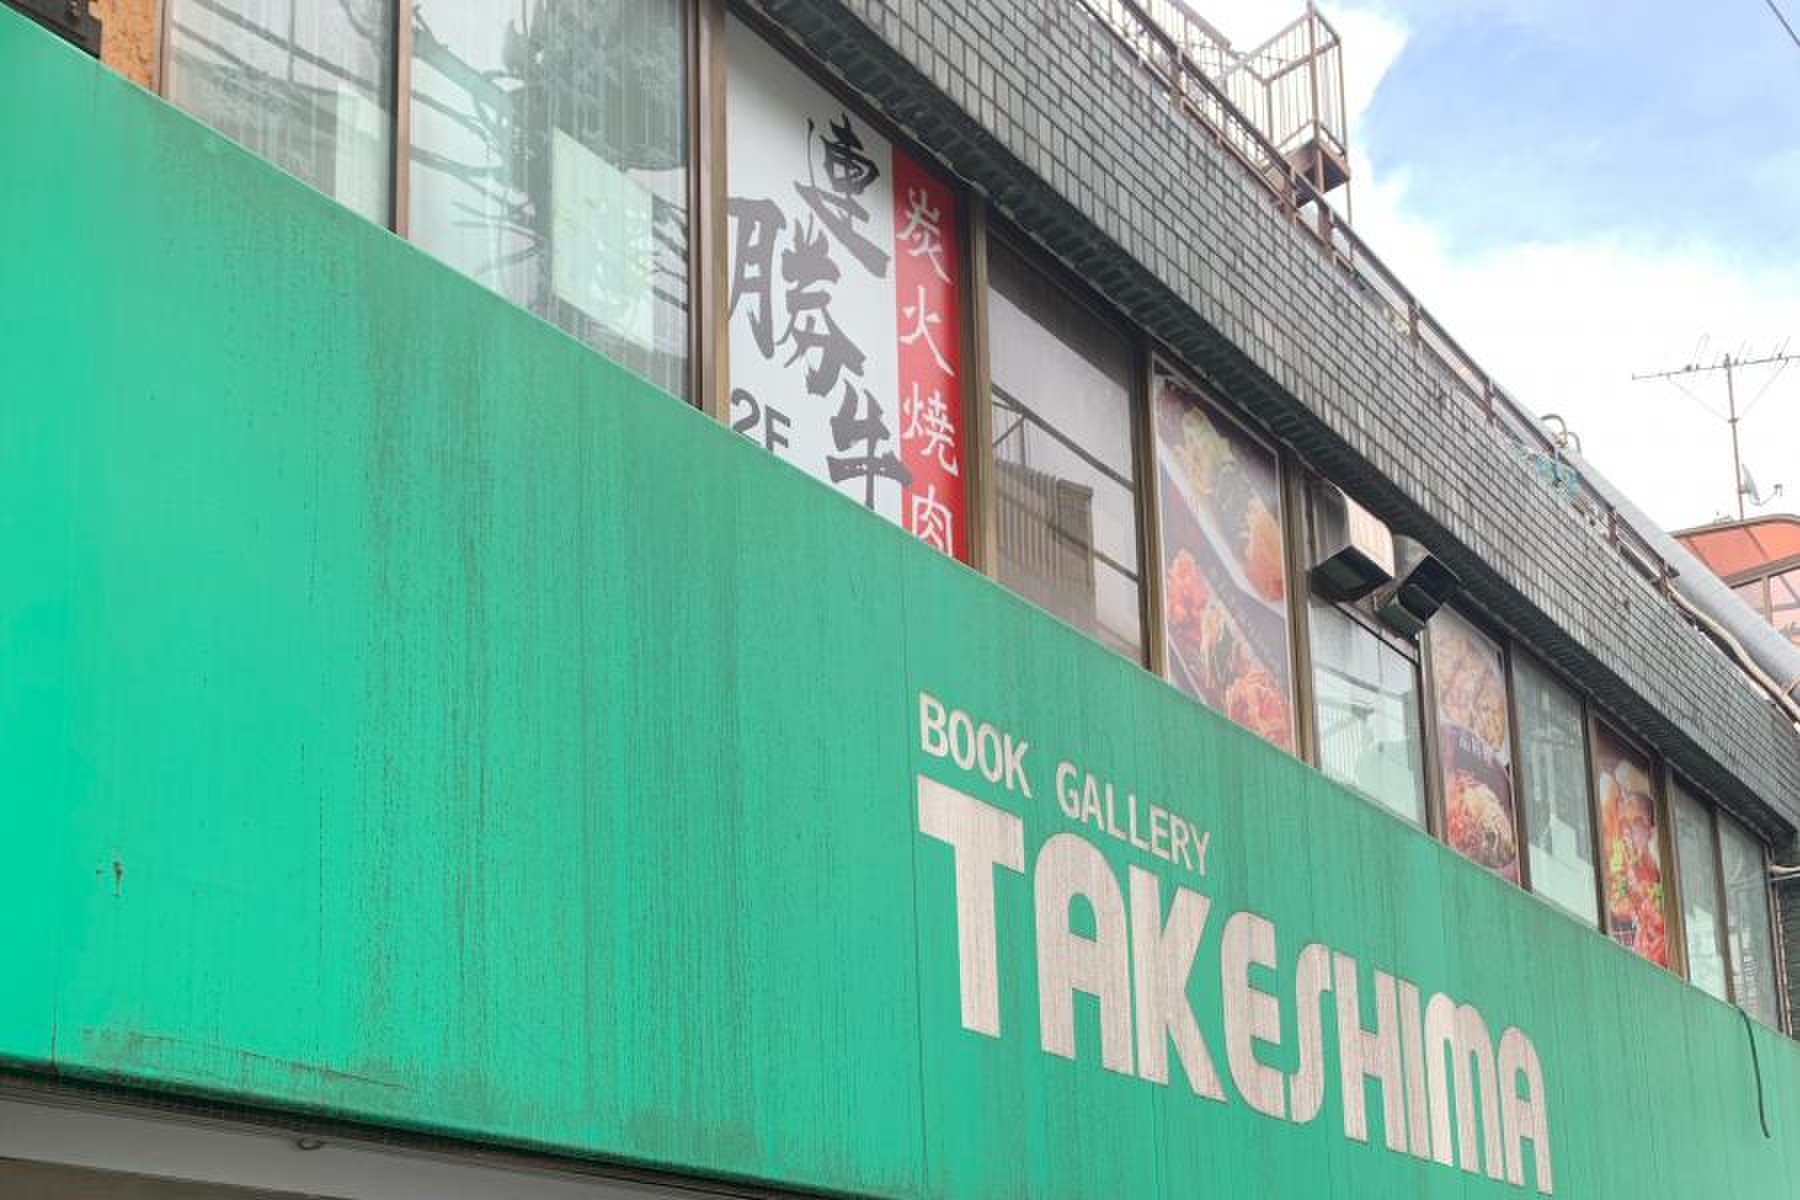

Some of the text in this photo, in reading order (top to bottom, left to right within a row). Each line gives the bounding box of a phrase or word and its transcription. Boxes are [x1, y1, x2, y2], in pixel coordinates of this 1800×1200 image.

[896, 188, 959, 558] 炭火焼肉
[918, 692, 1211, 877] BOOK GALLERY
[917, 774, 1553, 1197] TAKESHIMA
